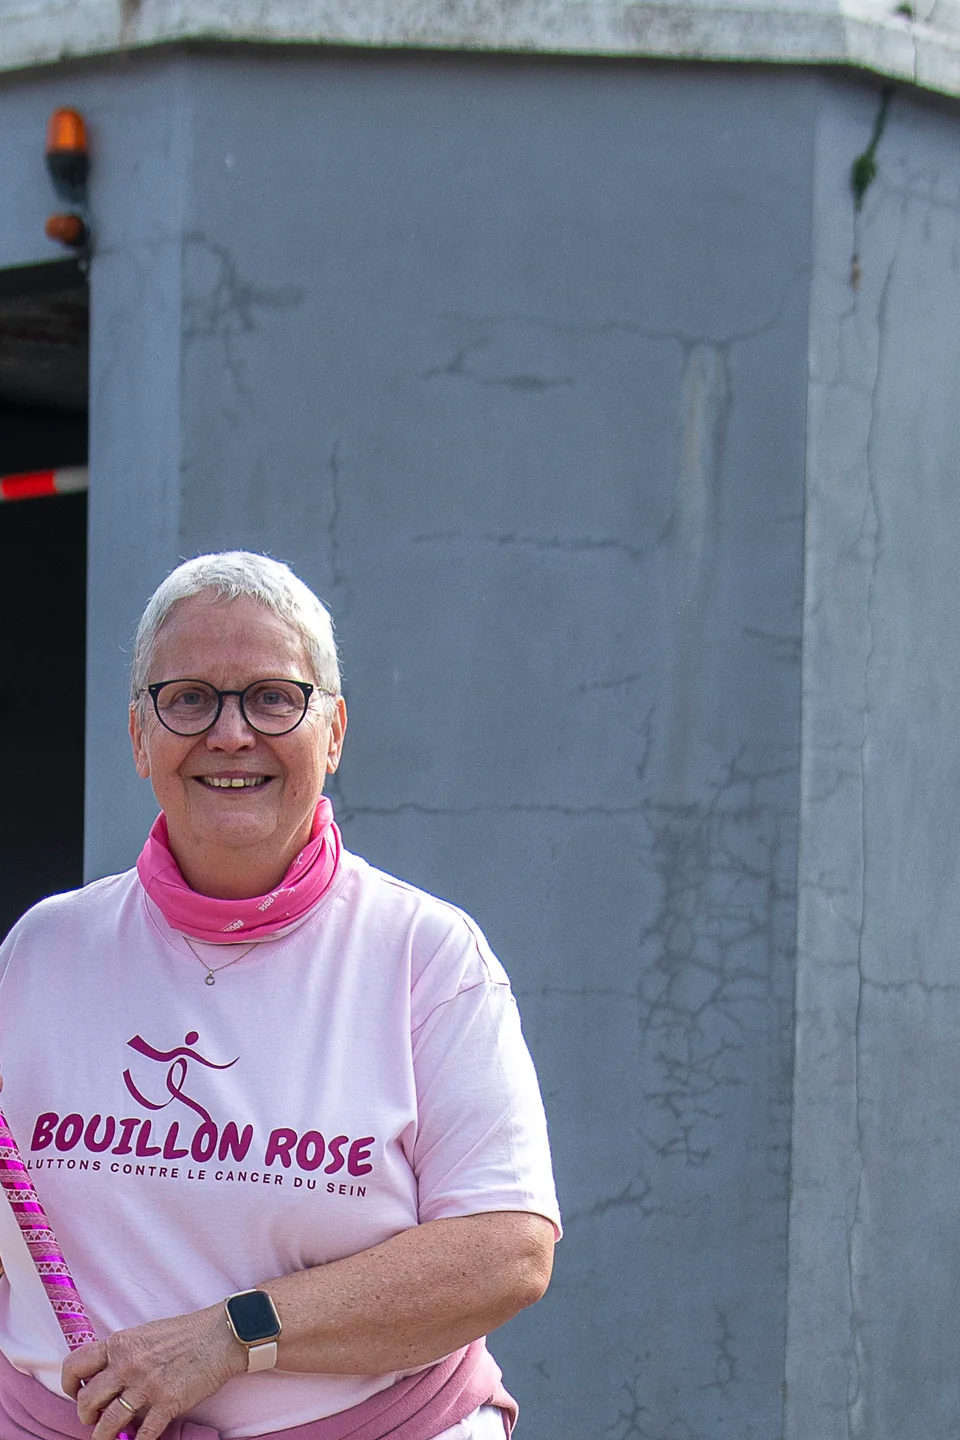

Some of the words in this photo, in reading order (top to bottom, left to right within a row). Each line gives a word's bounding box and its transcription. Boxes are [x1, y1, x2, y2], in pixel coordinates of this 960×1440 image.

[30, 1112, 254, 1163] BOUILLON
[265, 1128, 375, 1177] ROSE
[27, 1158, 101, 1171] LUTTONS
[110, 1163, 179, 1179] CONTRE
[188, 1169, 206, 1181] LE
[215, 1171, 284, 1185] CANCER
[294, 1177, 317, 1190] DU
[326, 1182, 367, 1197] SEIN
